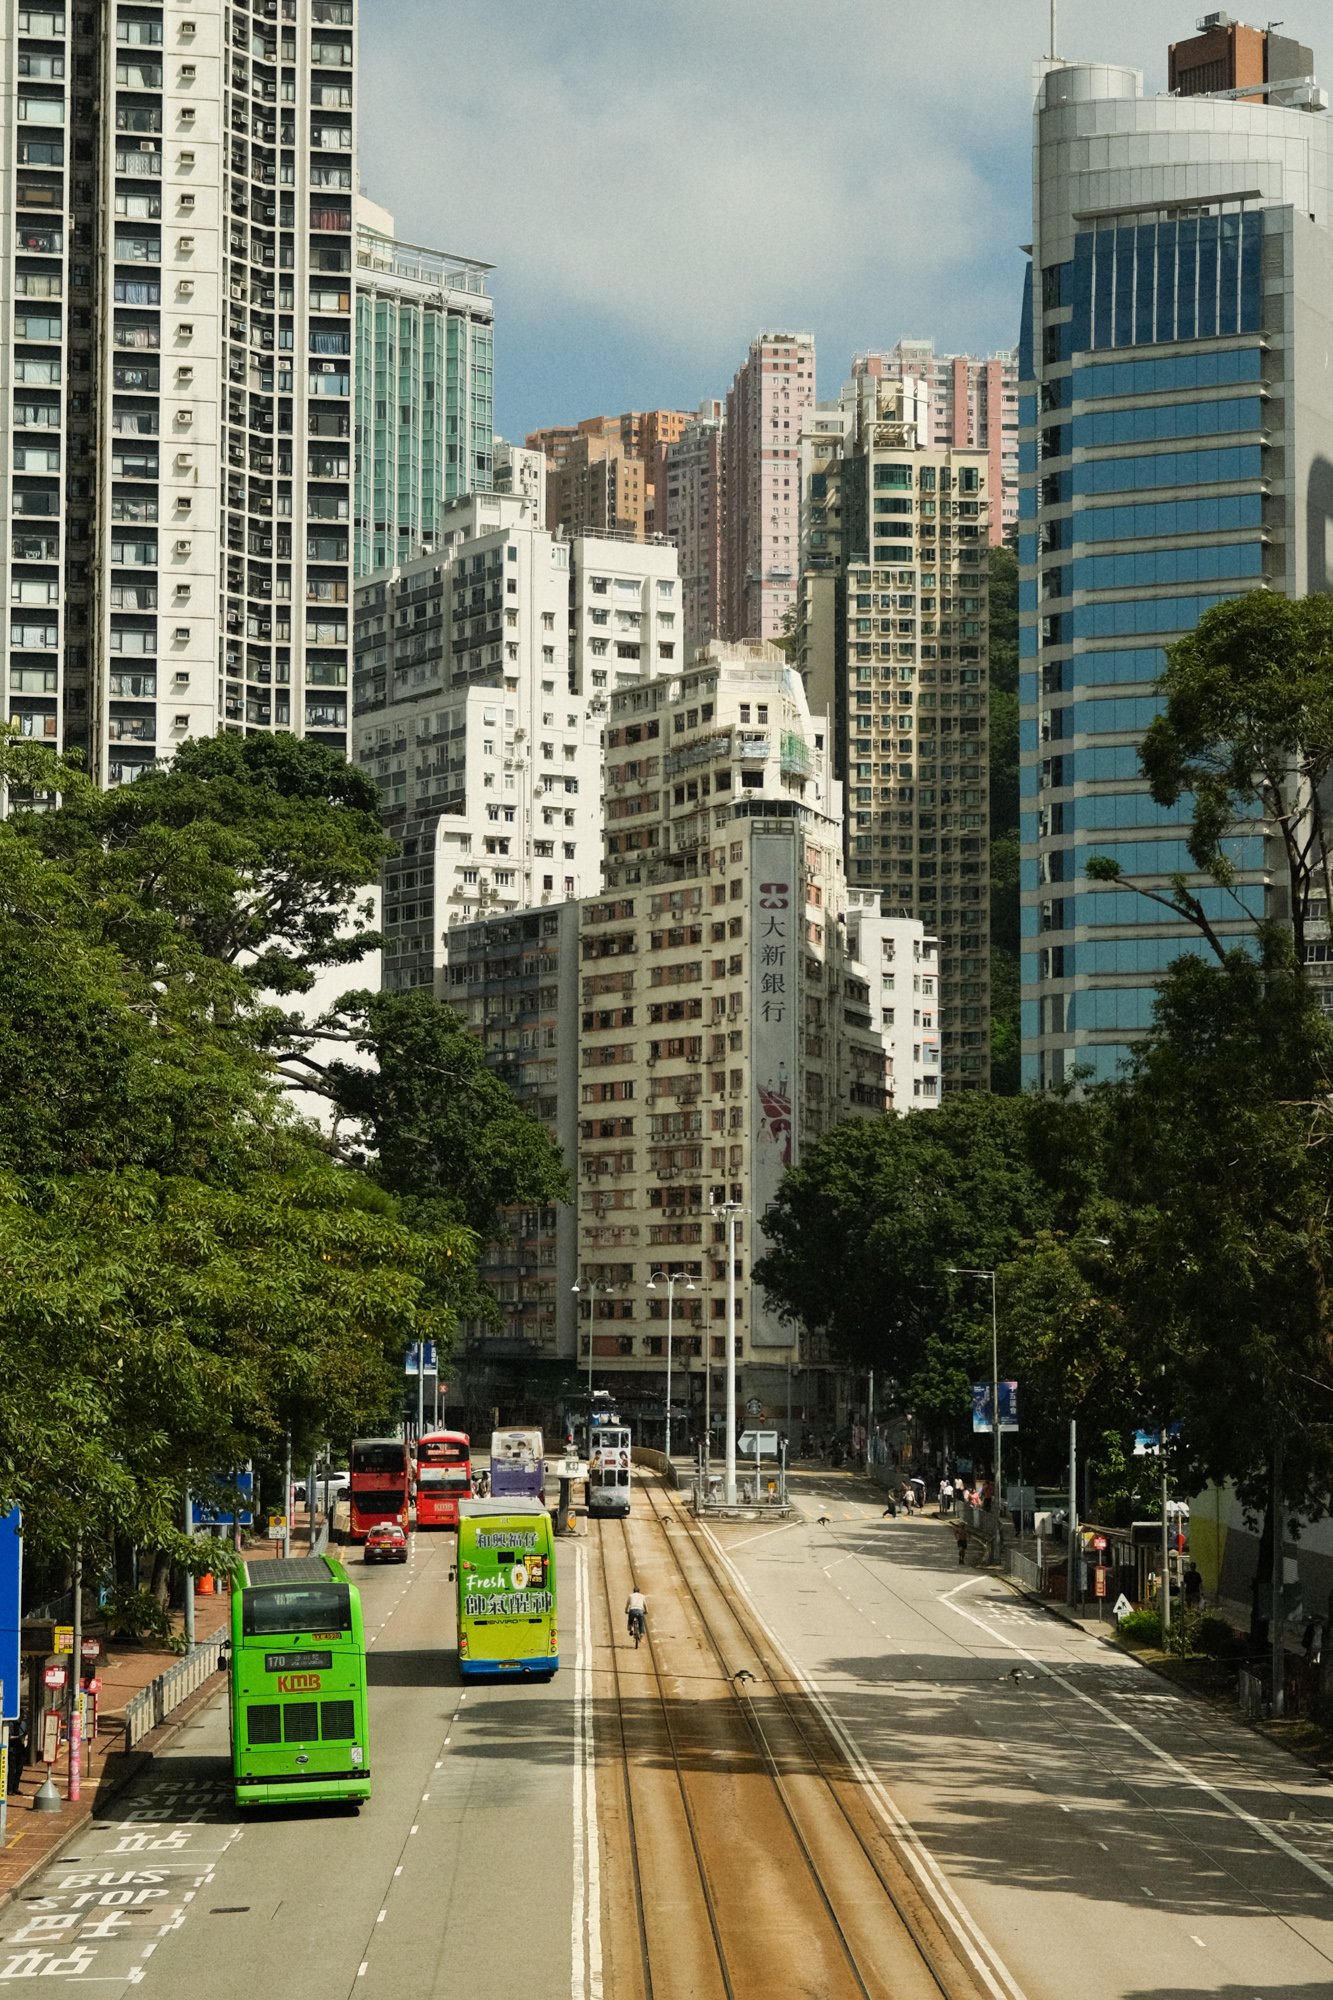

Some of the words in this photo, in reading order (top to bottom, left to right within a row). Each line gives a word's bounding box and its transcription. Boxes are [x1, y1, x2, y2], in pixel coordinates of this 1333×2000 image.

[760, 915, 786, 1023] 大新銀行
[476, 1532, 539, 1548] 和興福仔
[466, 1572, 506, 1590] Fresh
[465, 1591, 552, 1615] 帥氣醒神
[268, 1656, 286, 1667] 170
[278, 1674, 321, 1692] KMB
[117, 1807, 218, 1830] 巴士
[104, 1830, 192, 1853] 站
[57, 1869, 171, 1889] BUS
[27, 1888, 170, 1910] STOP
[7, 1910, 132, 1943] 巴士
[0, 1945, 98, 1978] 站
